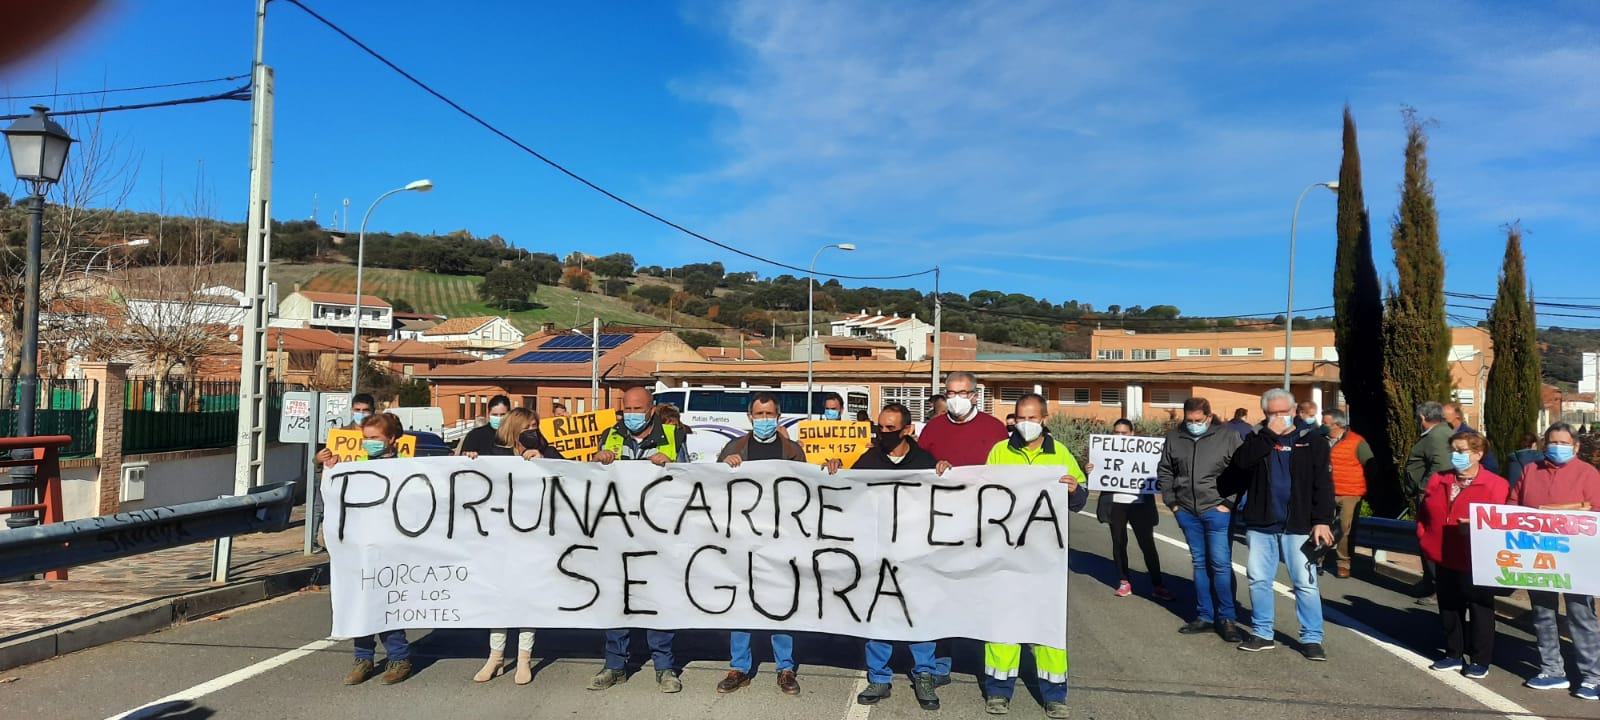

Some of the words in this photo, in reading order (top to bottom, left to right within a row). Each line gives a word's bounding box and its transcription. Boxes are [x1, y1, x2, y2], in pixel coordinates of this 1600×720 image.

[553, 413, 599, 437] RUTA
[800, 422, 867, 439] SOLUCIÓN
[334, 436, 363, 451] PO
[1103, 458, 1125, 471] IR
[1131, 461, 1150, 474] AL
[1476, 505, 1598, 536] NUESTROS
[1496, 549, 1523, 568] SE
[361, 563, 468, 591] HORCAJO
[557, 544, 914, 628] SEGURA
[1494, 566, 1572, 590] JUEGAN
[387, 590, 408, 605] DE
[421, 589, 451, 601] LOS
[385, 608, 461, 625] MONTES
